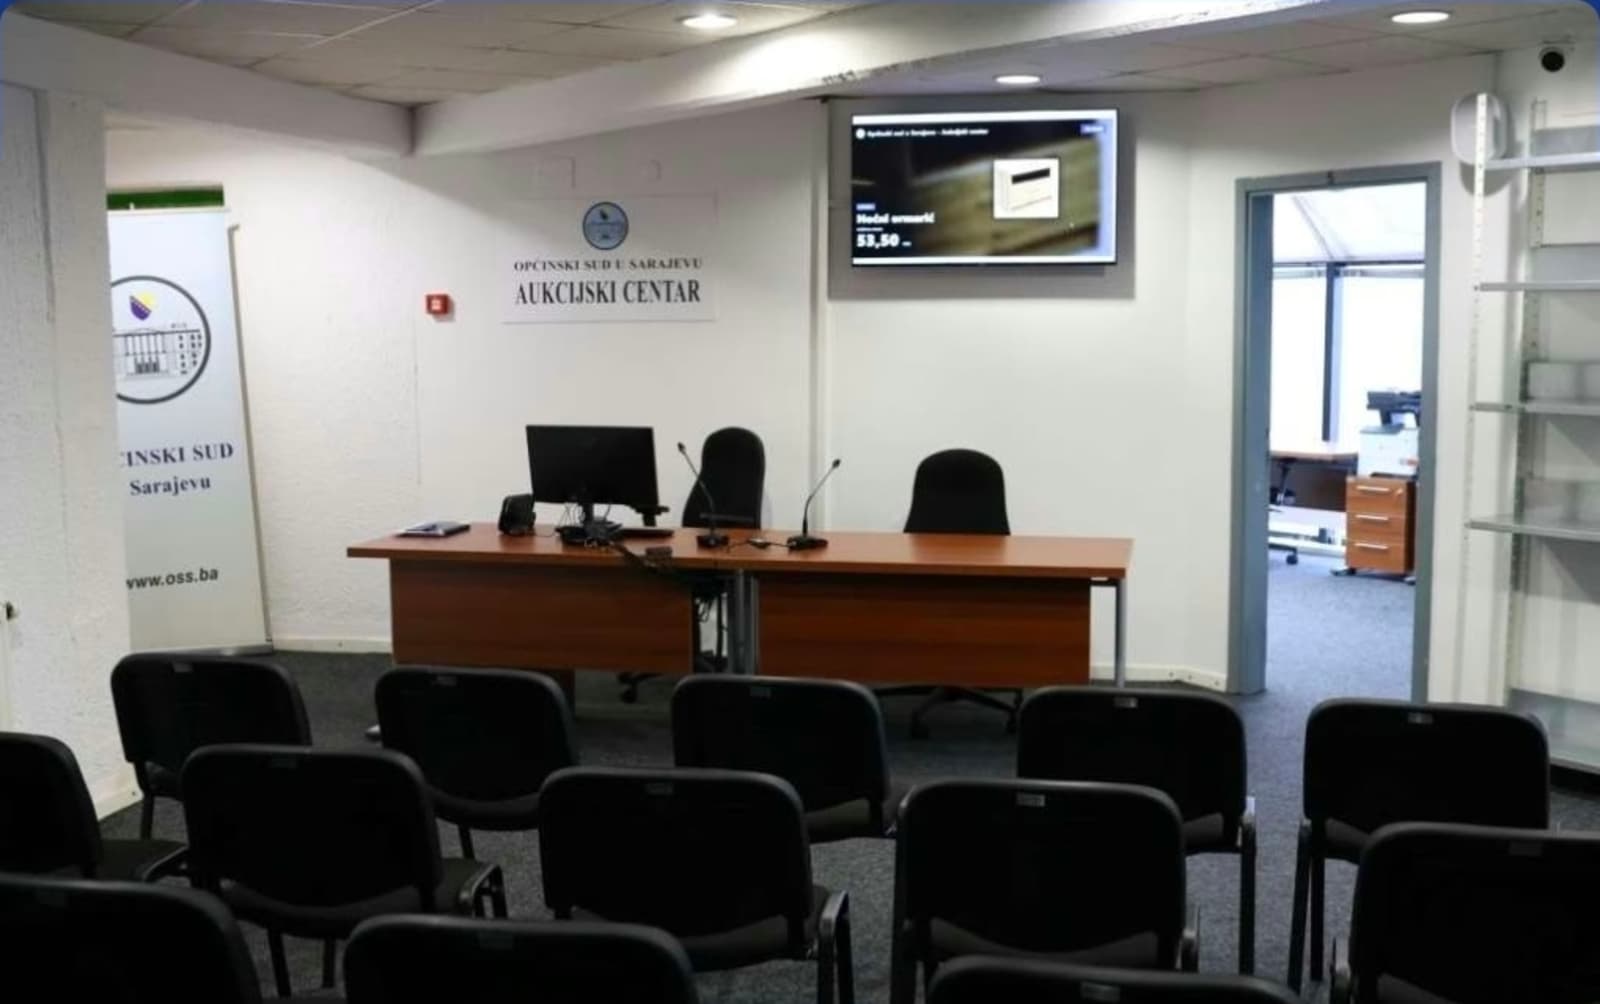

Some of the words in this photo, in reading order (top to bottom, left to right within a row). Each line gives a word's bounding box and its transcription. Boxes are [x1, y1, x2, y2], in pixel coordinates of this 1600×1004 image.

[857, 233, 899, 248] 53,50
[584, 259, 612, 270] SUD
[616, 258, 626, 270] U
[629, 257, 702, 270] SARAJEVU
[516, 281, 617, 304] AUKCIJSKI
[623, 279, 700, 303] CENTAR
[193, 443, 234, 461] SUD
[130, 476, 211, 496] Sarajevu
